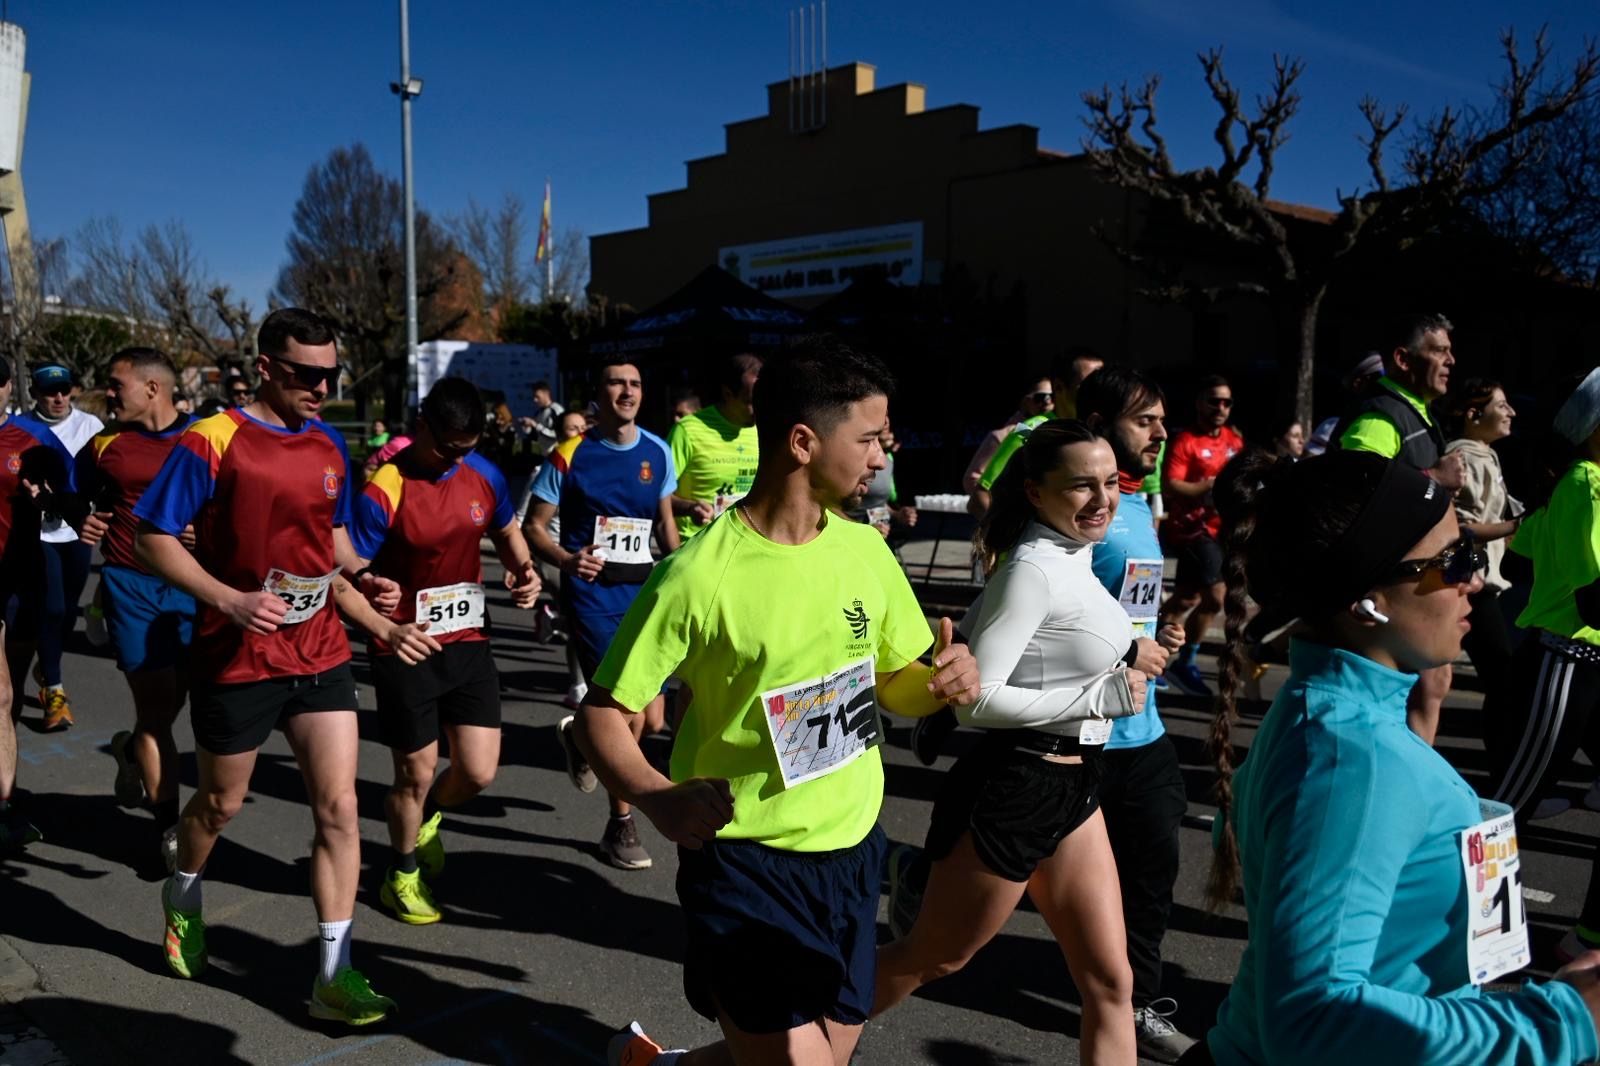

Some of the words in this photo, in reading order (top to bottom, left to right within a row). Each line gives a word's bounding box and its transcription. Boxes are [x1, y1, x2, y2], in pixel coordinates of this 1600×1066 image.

[806, 268, 834, 286] DEL
[607, 533, 641, 552] 110
[1130, 582, 1156, 604] 124
[429, 600, 470, 623] 519
